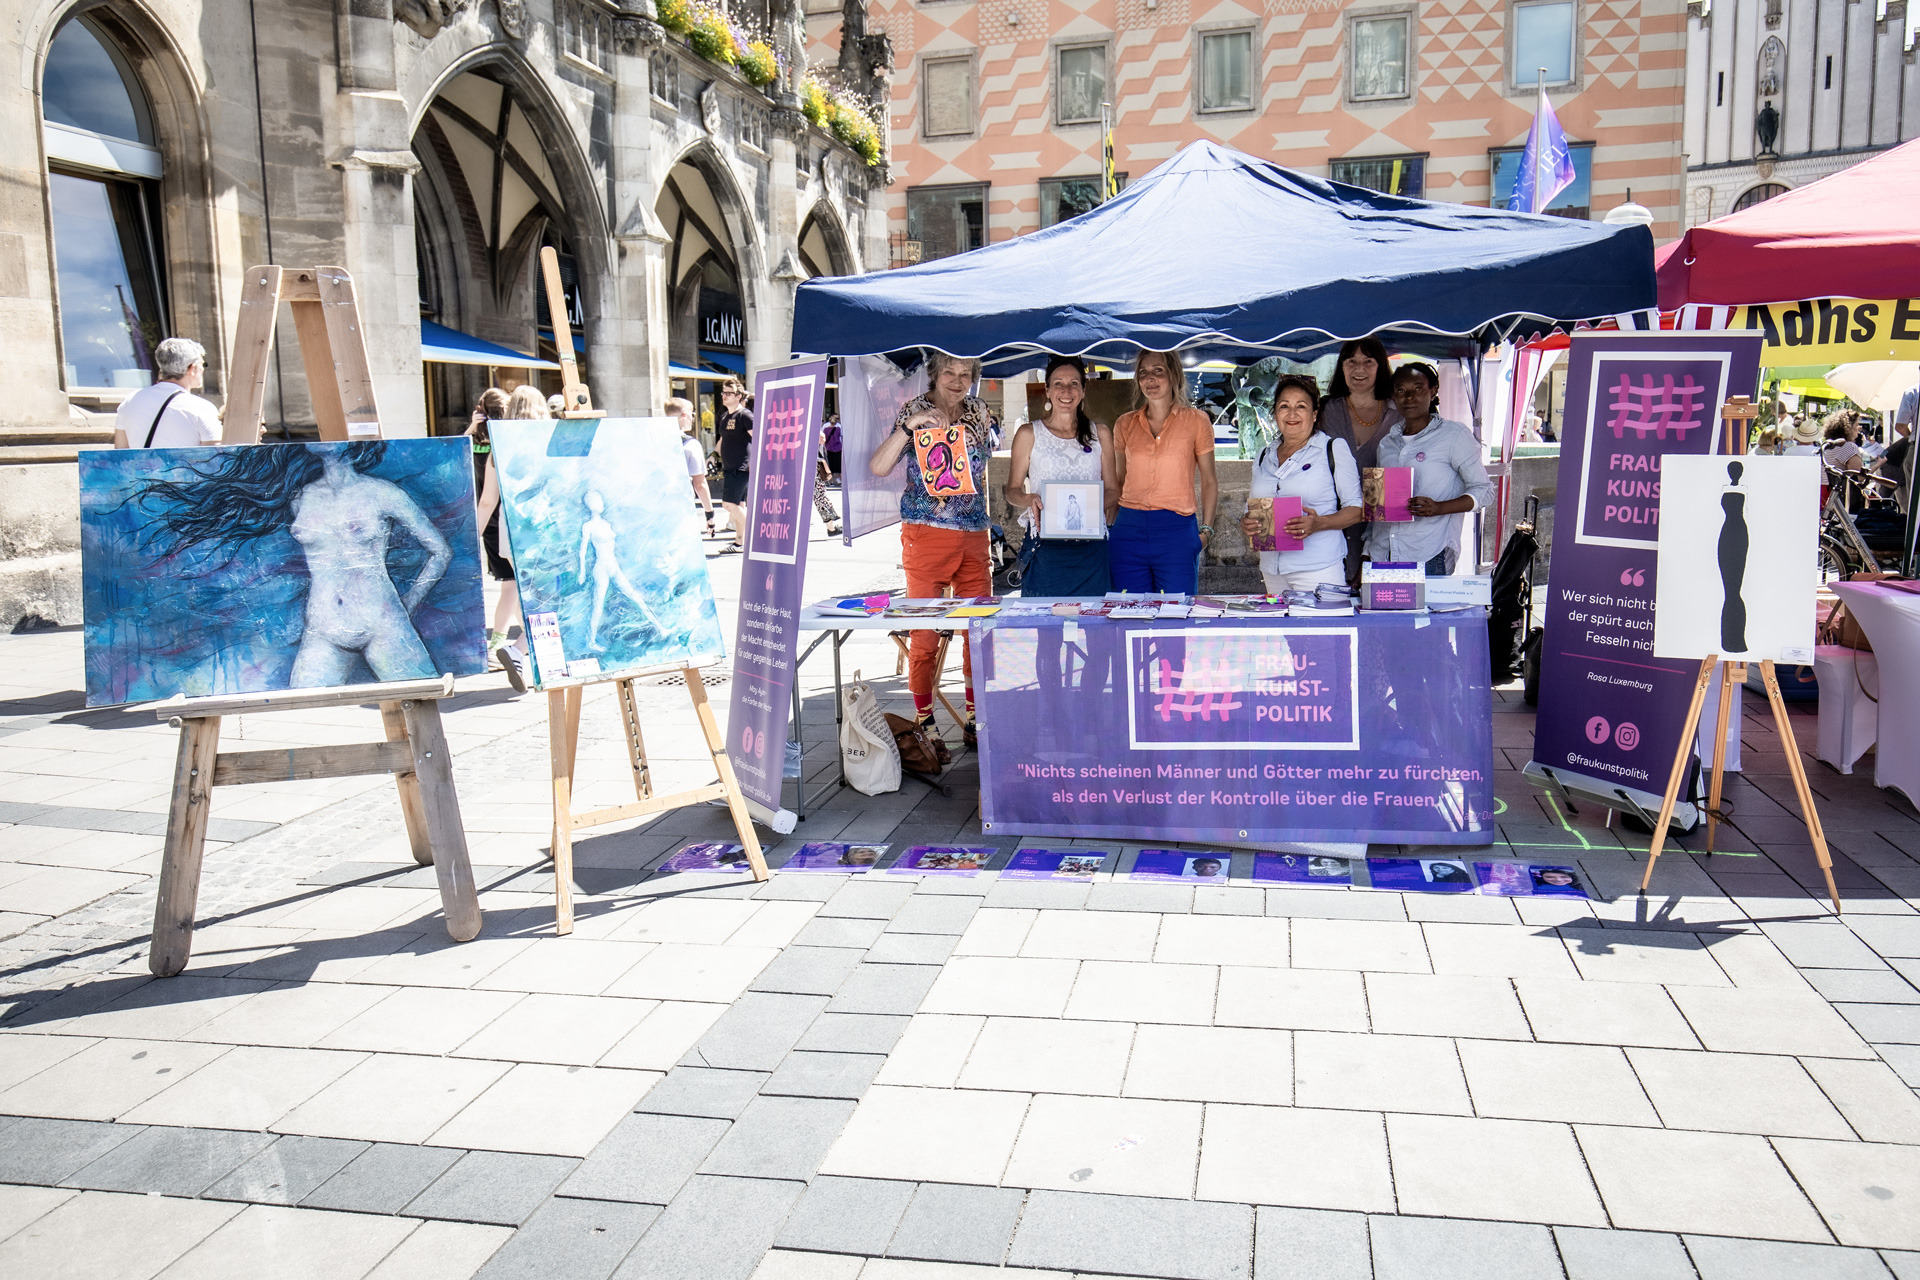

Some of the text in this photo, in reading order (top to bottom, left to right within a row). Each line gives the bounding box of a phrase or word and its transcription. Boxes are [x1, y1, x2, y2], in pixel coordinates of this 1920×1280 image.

[705, 312, 745, 346] J.G.MAY
[1746, 299, 1879, 347] Adhs
[1609, 453, 1661, 474] FRAU
[764, 474, 788, 490] FRAU-
[1607, 480, 1661, 498] KUNS
[762, 498, 791, 515] KUNST-
[1604, 505, 1659, 525] POLIT
[760, 522, 790, 540] POLITIK
[1562, 590, 1656, 611] Wer sich nicht b
[780, 608, 791, 619] Haut,
[1568, 611, 1654, 631] der spürt auch
[746, 619, 765, 630] sondern
[748, 634, 762, 646] Macht
[1586, 630, 1655, 651] Fesseln nich
[772, 657, 788, 670] Leben!
[1254, 654, 1317, 672] FRAU-
[1254, 679, 1330, 697] KUNST-
[1587, 671, 1654, 693] Rosa Luxemburg
[1256, 704, 1333, 722] POLITIK
[842, 747, 866, 758] BER
[1017, 762, 1484, 784] "Nichts scheinen Männer und Götter mehr zu fürchten,
[1566, 751, 1649, 782] @fraukunstpolitik
[1052, 789, 1074, 804] als
[1079, 789, 1107, 804] den
[1113, 789, 1173, 804] Verlust
[1178, 789, 1205, 805] der
[1211, 789, 1290, 806] Kontrolle
[1295, 790, 1336, 806] über
[1341, 790, 1368, 806] die
